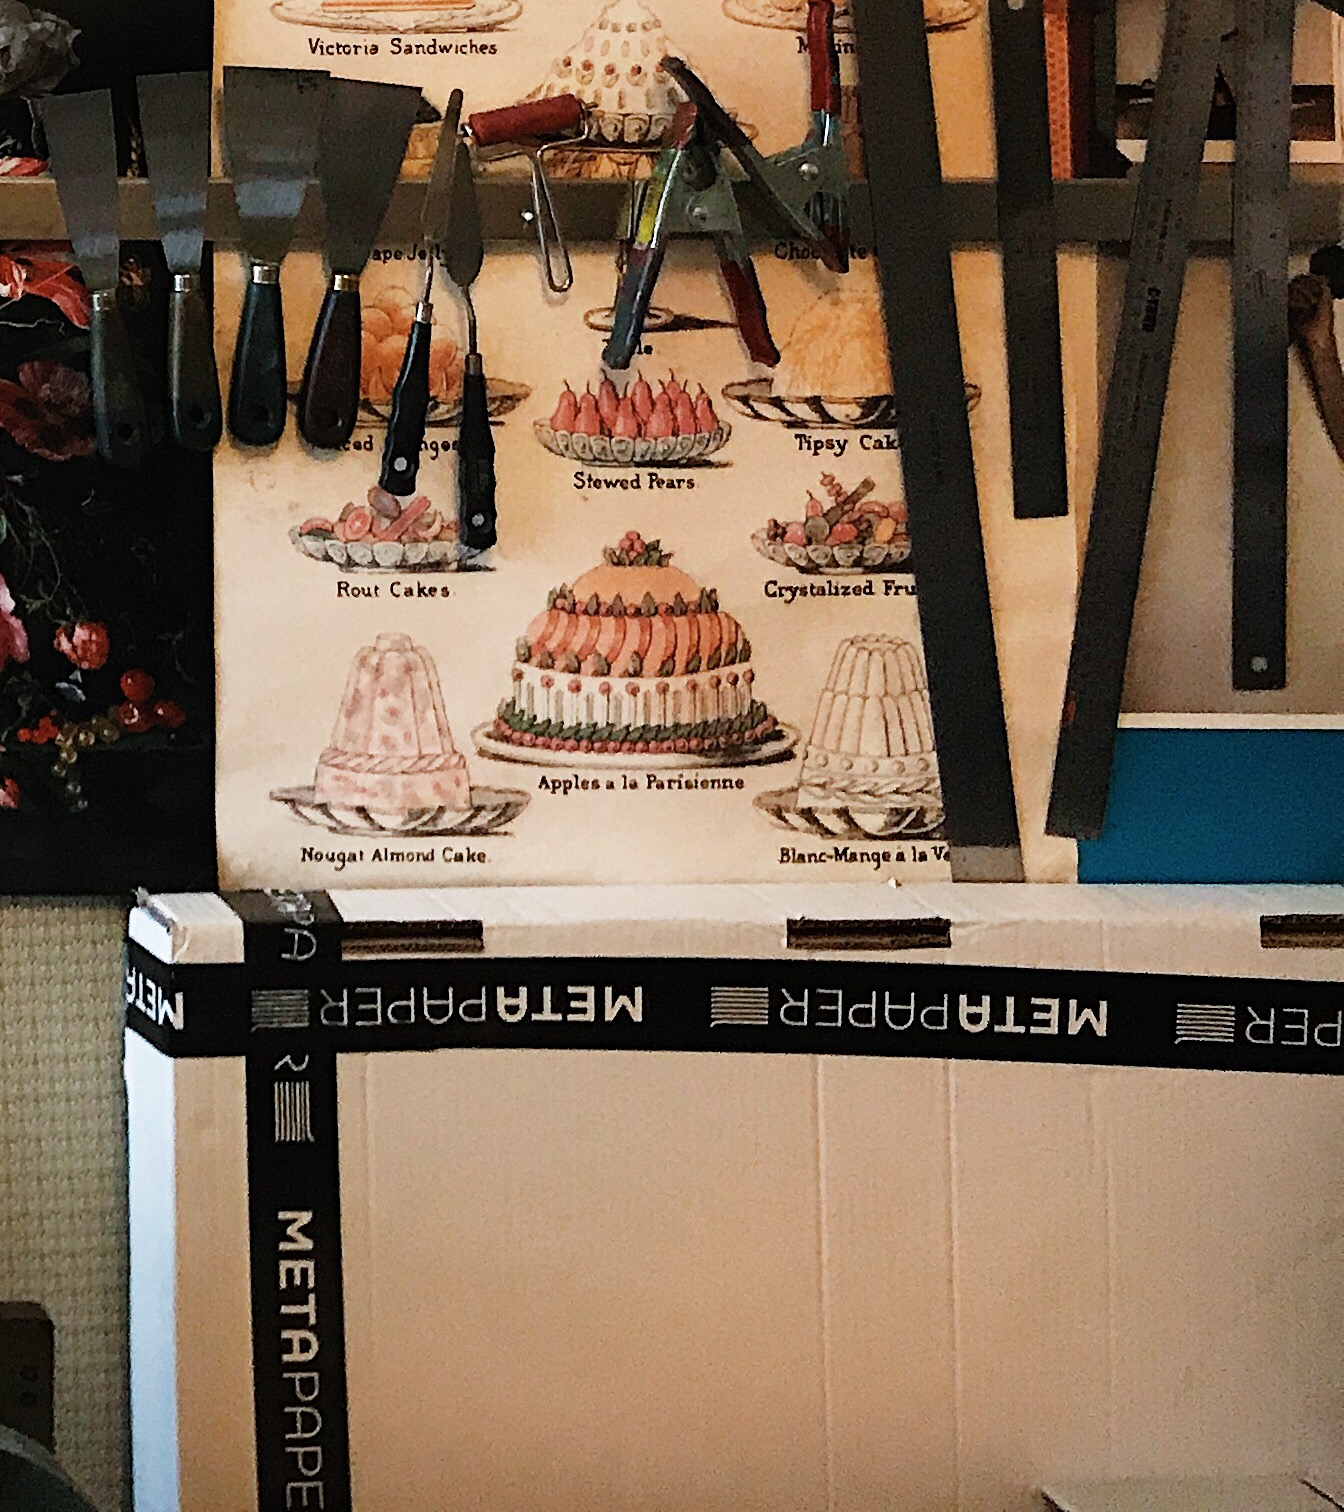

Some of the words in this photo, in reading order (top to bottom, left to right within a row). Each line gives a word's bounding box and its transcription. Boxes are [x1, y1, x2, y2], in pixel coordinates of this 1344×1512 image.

[309, 38, 378, 55] Victoria
[390, 38, 497, 55] Sandwiches
[795, 434, 848, 457] Tipsy
[859, 433, 900, 450] Cak
[574, 471, 641, 490] Stewed
[337, 581, 379, 597] Rout
[765, 580, 875, 604] Crystalized
[539, 774, 600, 795] Apples
[622, 775, 638, 789] la
[647, 774, 744, 790] Parisienne
[301, 847, 363, 871] Nougat
[372, 848, 434, 862] Almond
[780, 847, 891, 870] Blanc-Mange
[912, 846, 927, 862] la
[320, 983, 644, 1028] METAPAPER
[778, 986, 1109, 1038] METAPAPER
